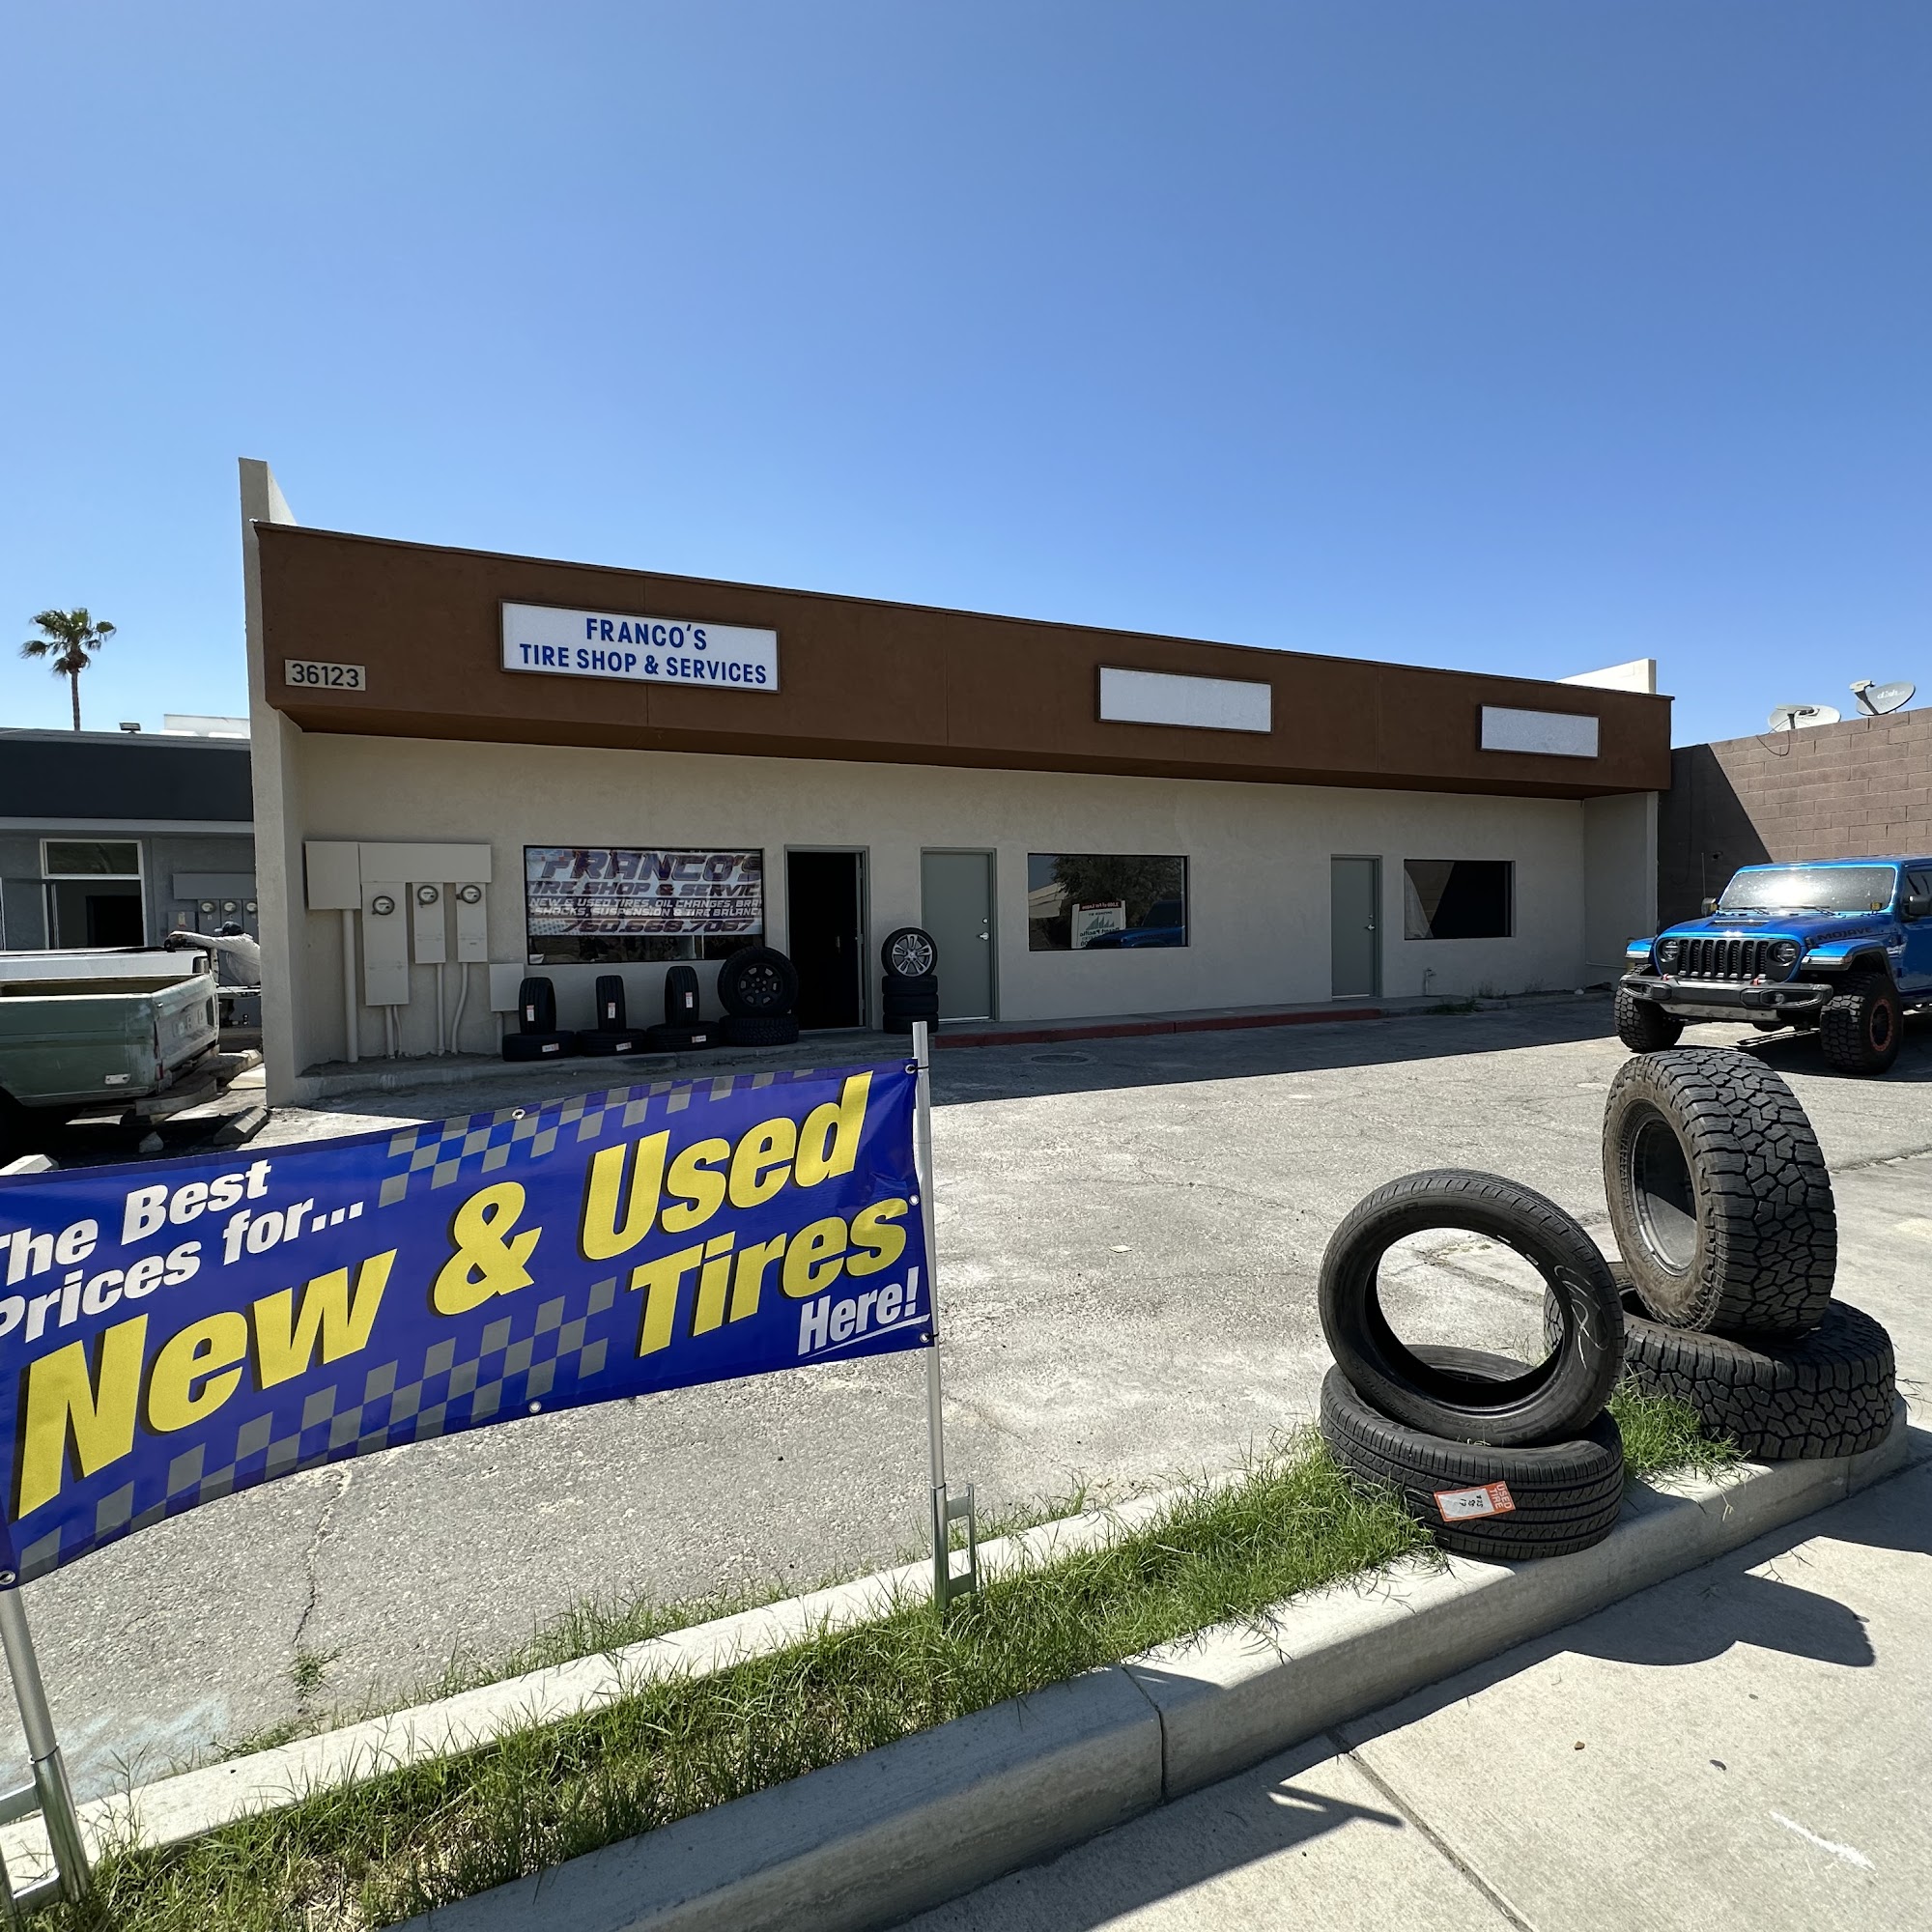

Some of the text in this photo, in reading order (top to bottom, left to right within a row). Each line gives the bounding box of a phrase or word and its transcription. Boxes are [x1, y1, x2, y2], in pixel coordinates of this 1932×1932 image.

[585, 617, 707, 651] FRANCO'S
[292, 663, 360, 688] 36123
[520, 643, 767, 685] TIRE SHOP & SERVICES
[541, 850, 761, 881] FRANCO'S
[578, 898, 611, 907] USED
[655, 899, 673, 908] OIL
[676, 899, 733, 910] CHANGES,
[582, 882, 651, 895] SHOP
[657, 884, 673, 896] &
[1817, 927, 1873, 941] MOJAVE
[121, 1159, 271, 1245] Best
[223, 1198, 363, 1265] for...
[629, 1198, 908, 1358] Tires
[12, 1070, 873, 1520] New & Used
[798, 1266, 919, 1355] Here!
[1489, 1487, 1503, 1509] TIRE
[1496, 1484, 1513, 1509] USED
